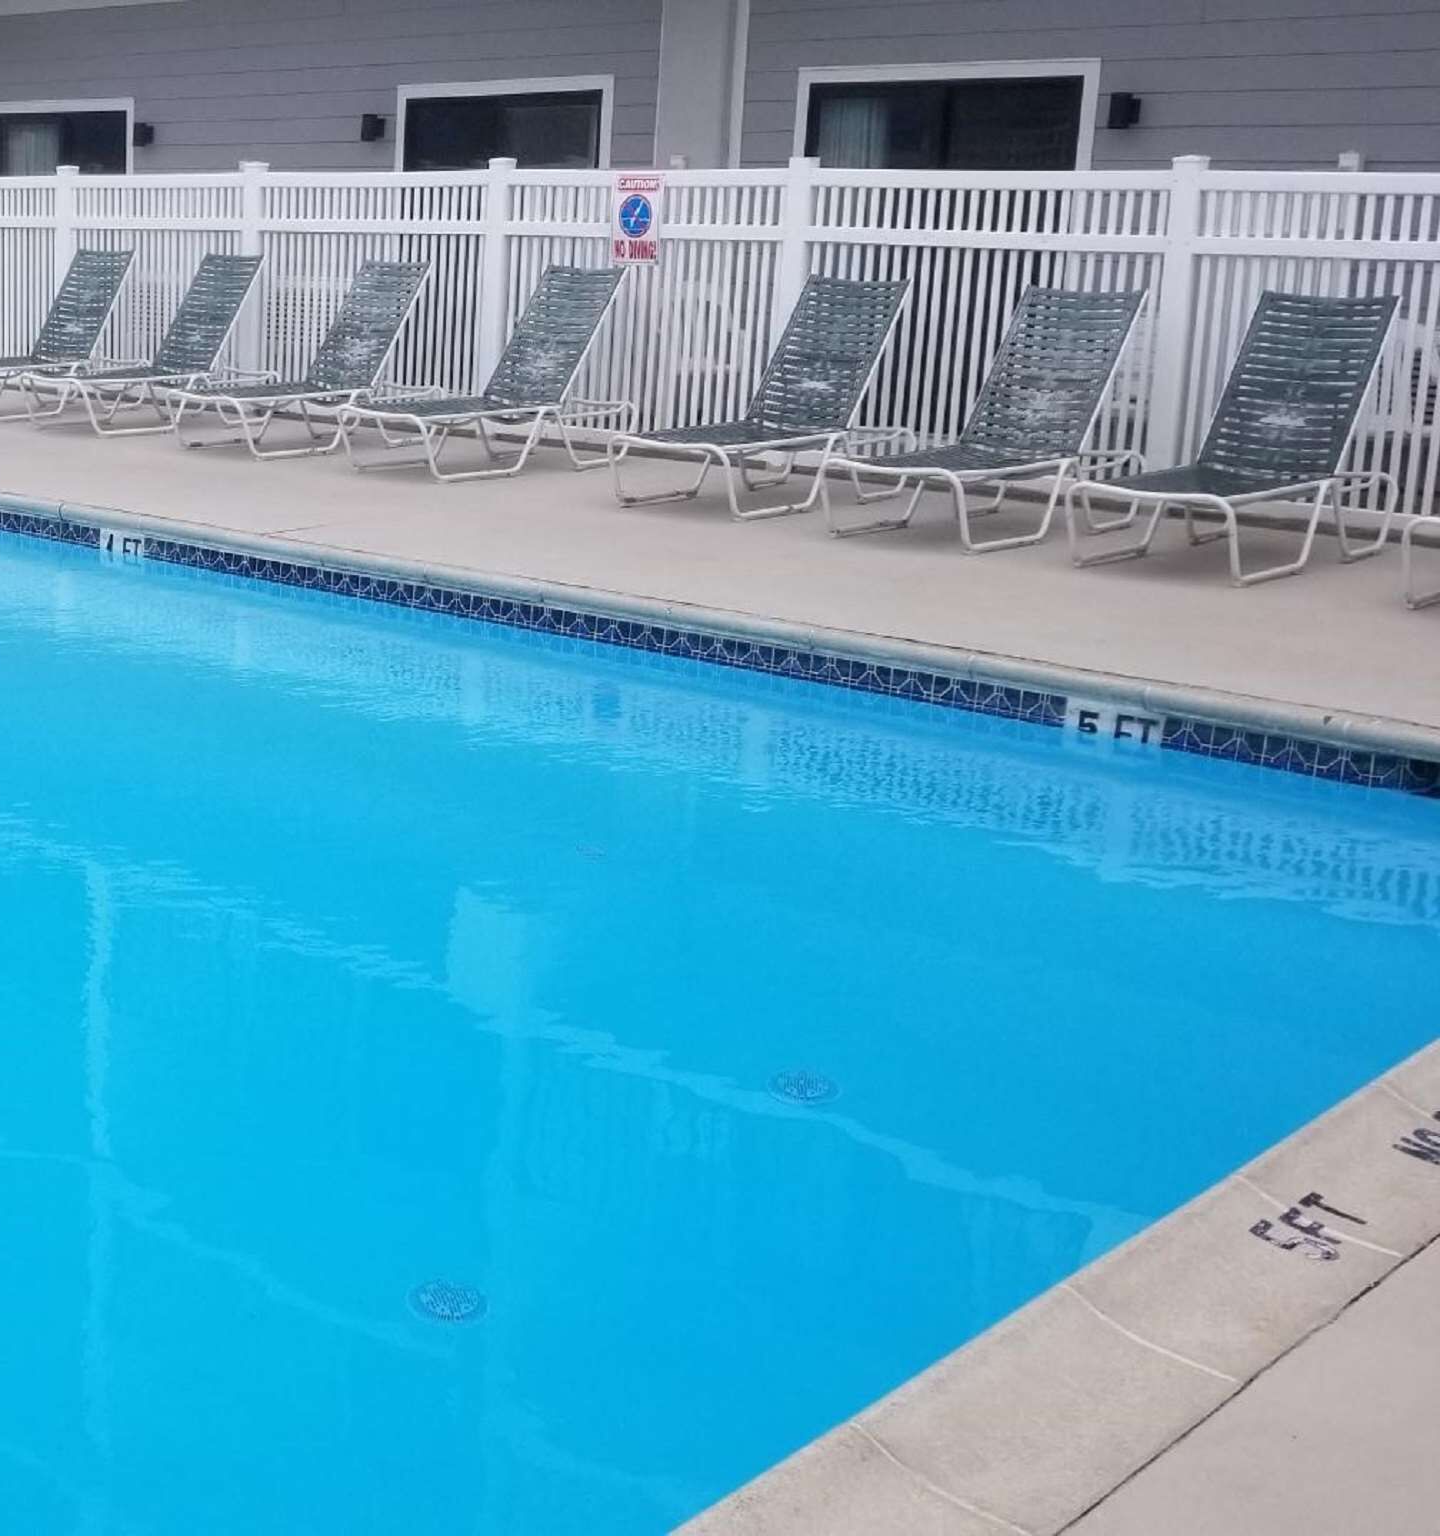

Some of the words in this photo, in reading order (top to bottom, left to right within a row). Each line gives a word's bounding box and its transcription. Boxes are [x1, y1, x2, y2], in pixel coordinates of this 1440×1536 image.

[614, 240, 626, 258] NO
[628, 240, 657, 259] DIVING!
[1077, 709, 1100, 734] 5
[1113, 713, 1160, 744] FT
